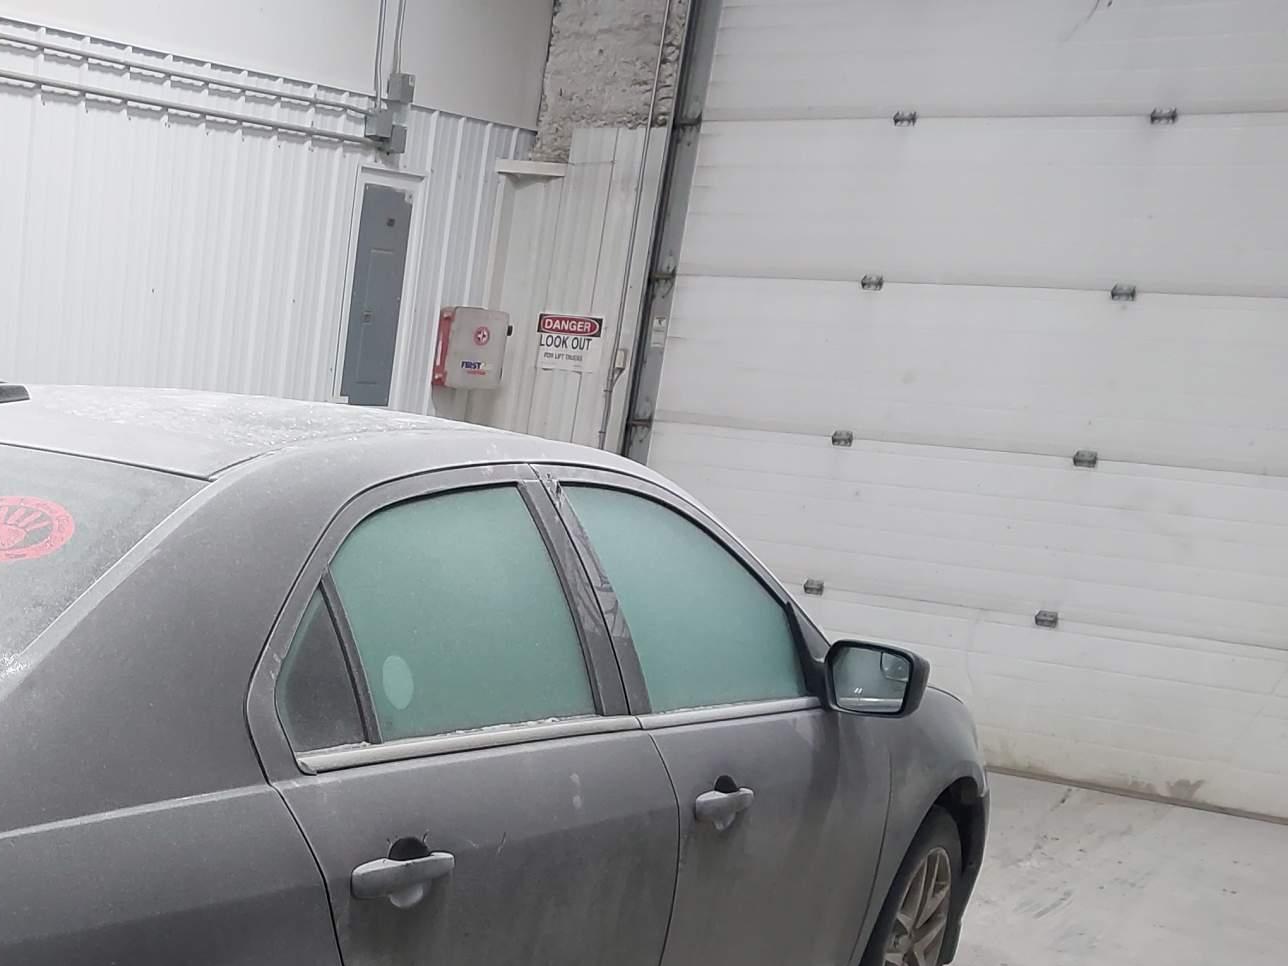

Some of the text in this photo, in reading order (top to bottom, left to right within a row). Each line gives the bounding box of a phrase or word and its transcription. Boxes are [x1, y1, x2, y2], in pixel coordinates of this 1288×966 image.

[543, 318, 592, 333] DANGER
[539, 334, 593, 351] LOOK OUT
[543, 351, 554, 359] FOR
[554, 352, 565, 360] LIFT
